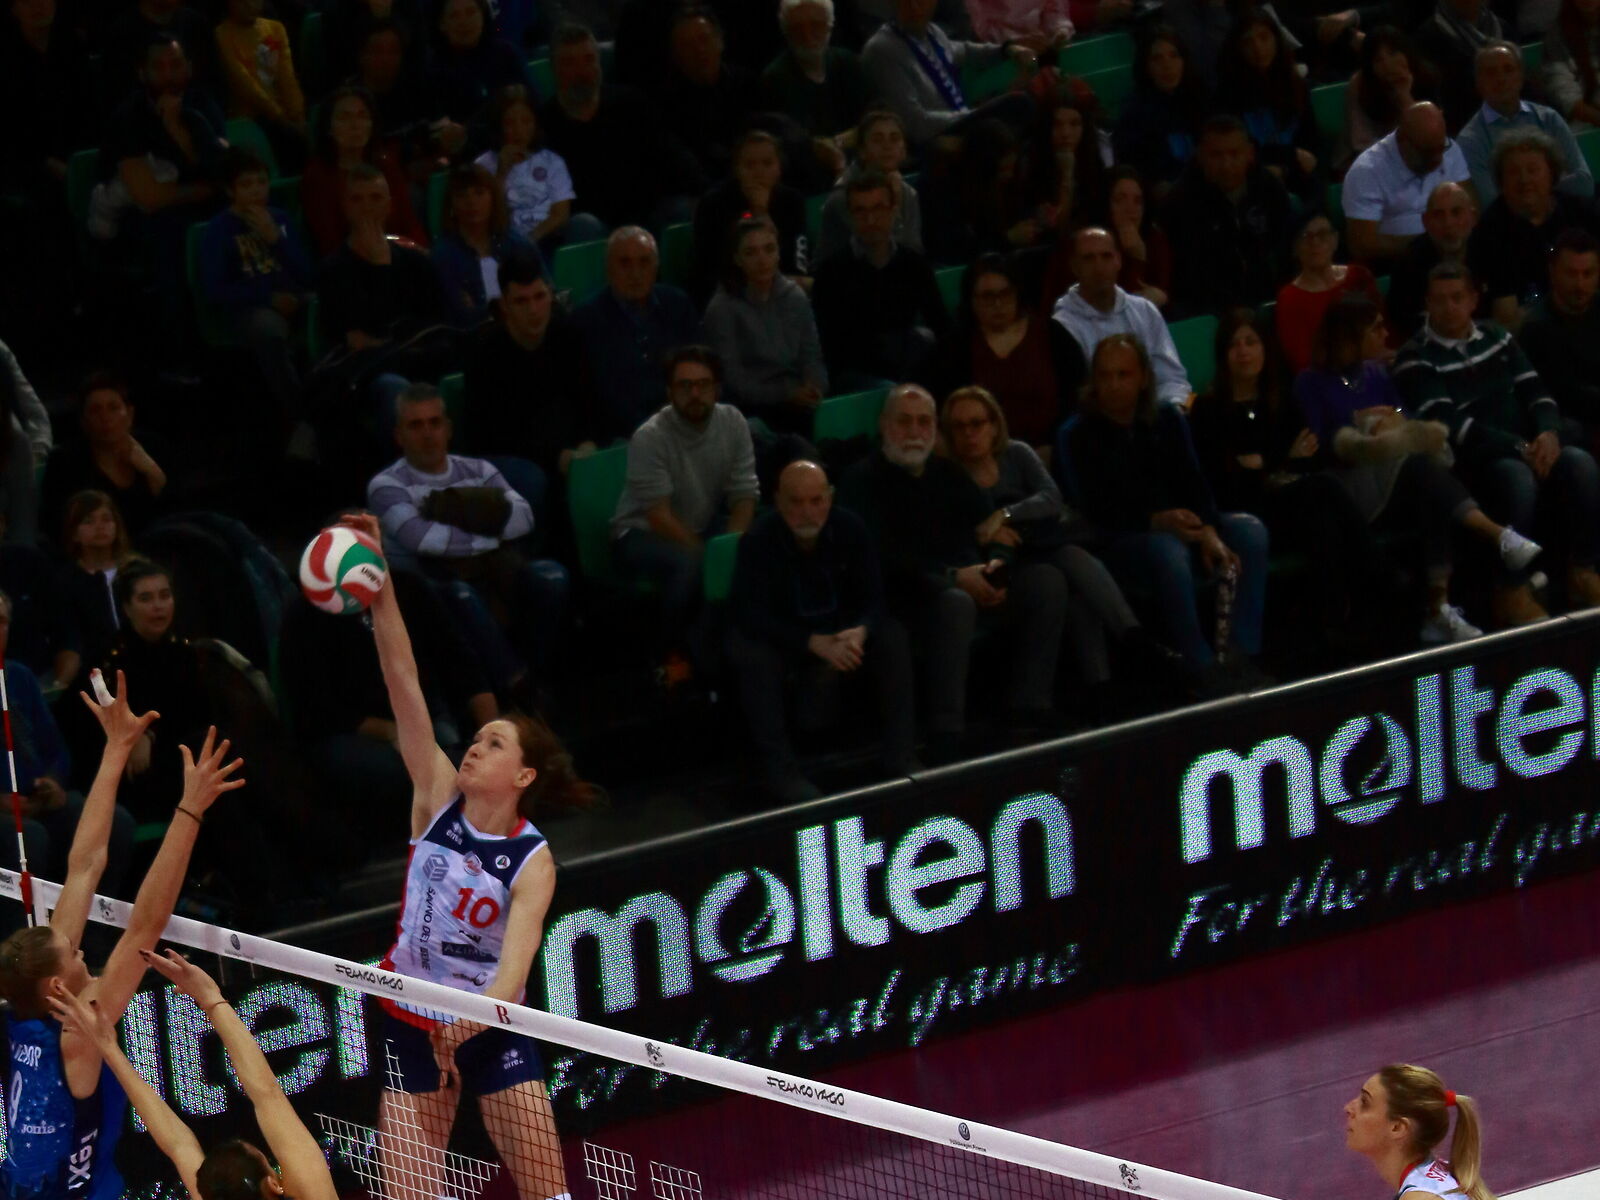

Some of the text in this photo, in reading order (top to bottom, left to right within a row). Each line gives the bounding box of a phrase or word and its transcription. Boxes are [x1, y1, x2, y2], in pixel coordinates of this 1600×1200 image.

[1180, 665, 1600, 864] molte
[452, 887, 500, 929] 10
[544, 790, 1077, 1019] molten
